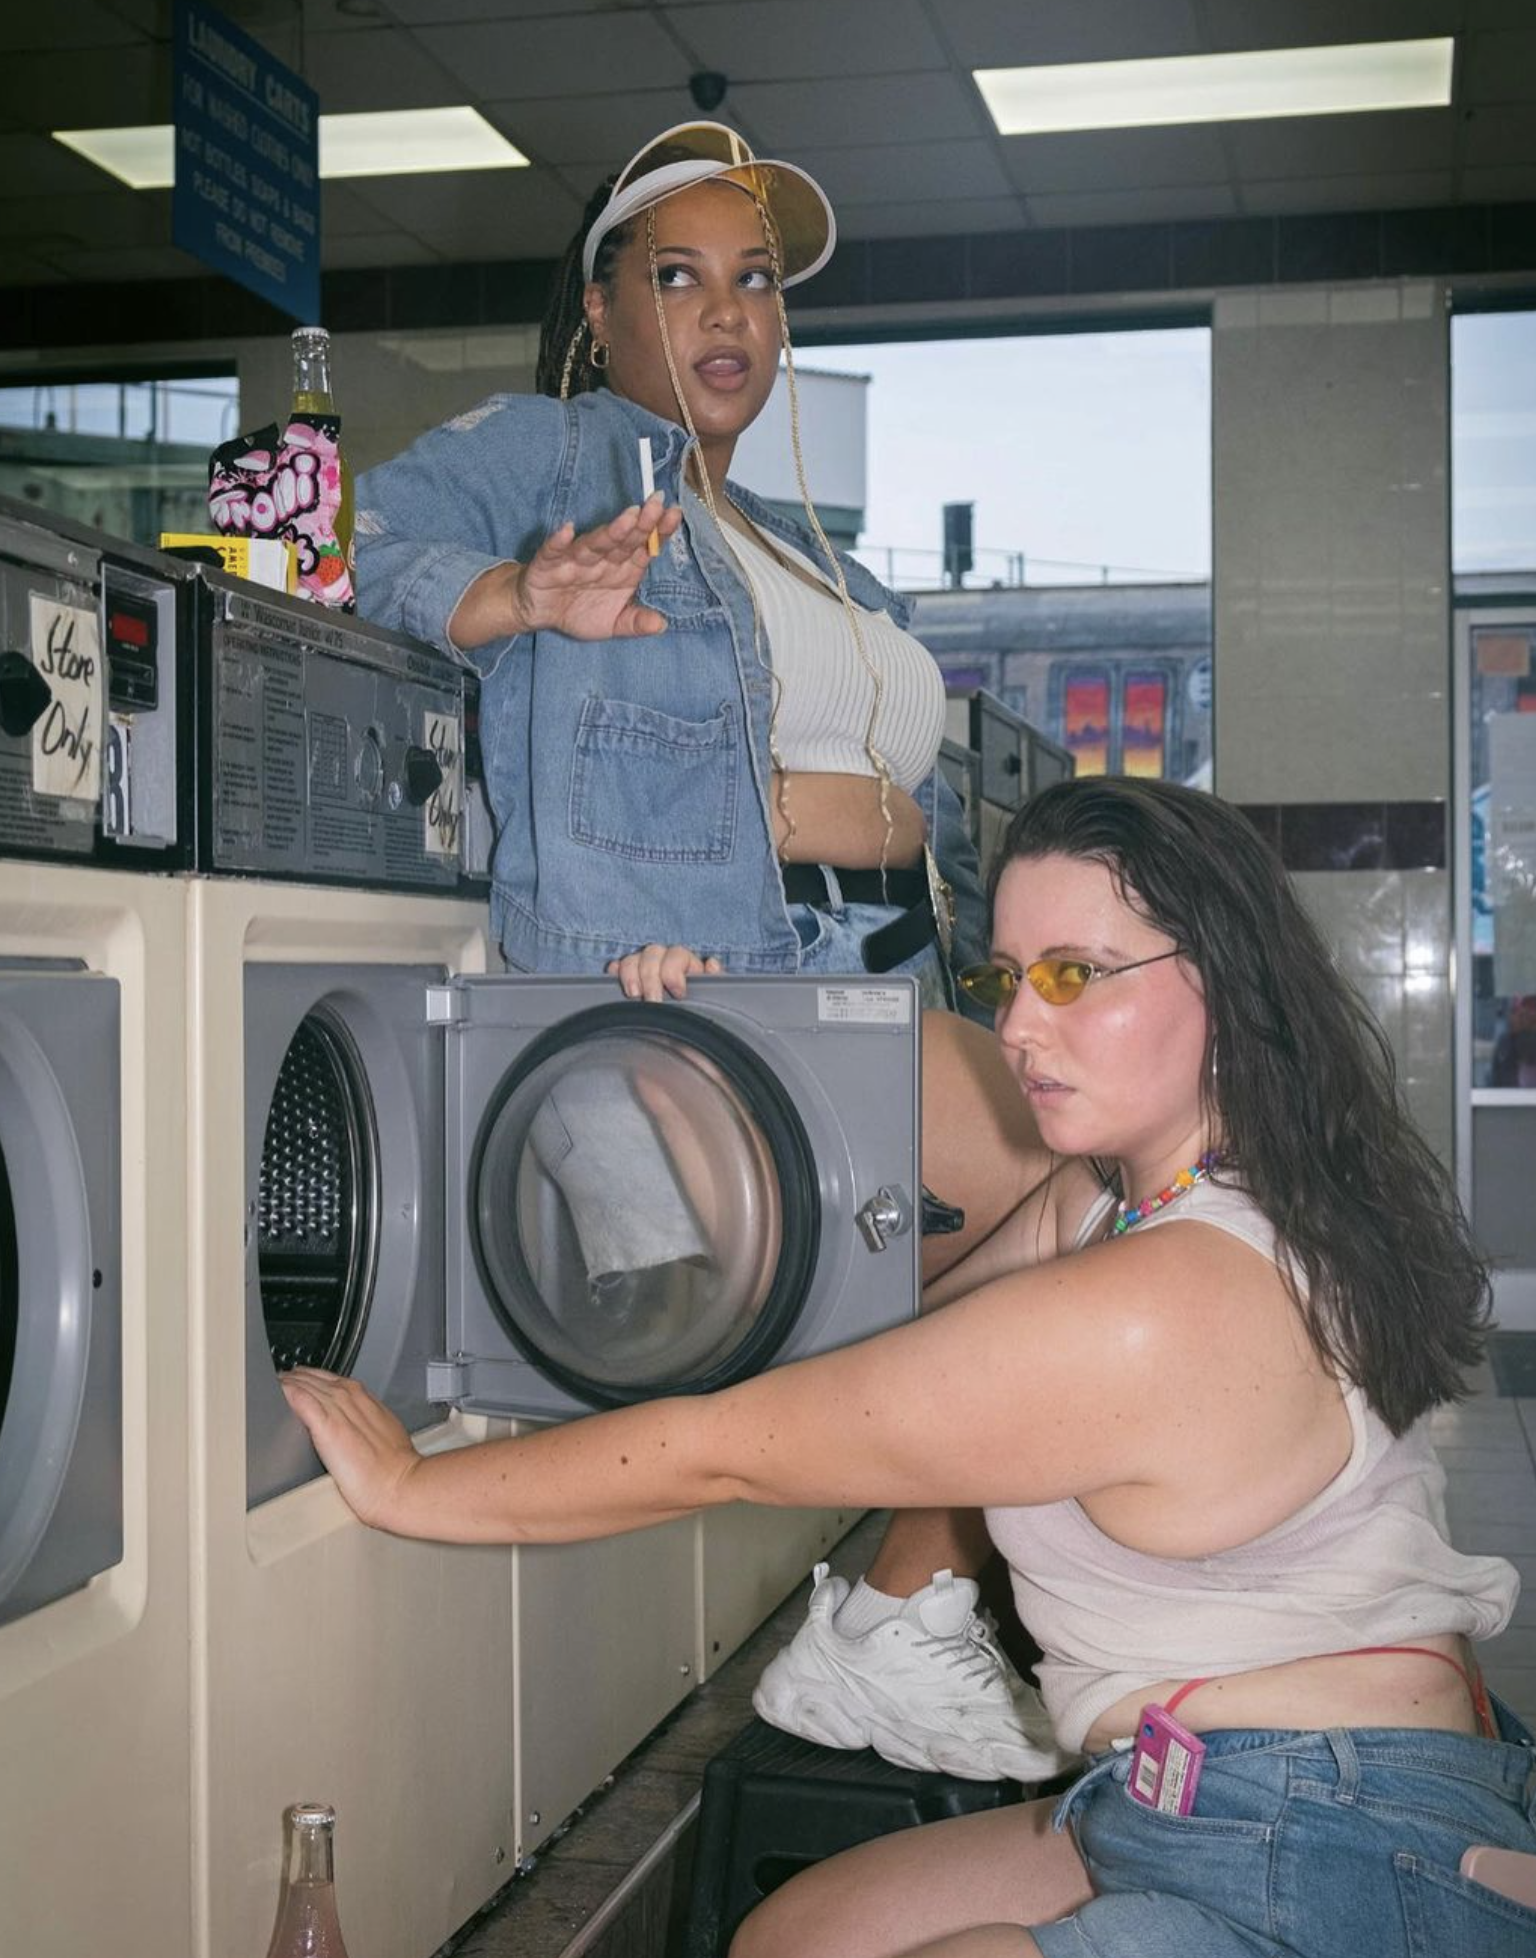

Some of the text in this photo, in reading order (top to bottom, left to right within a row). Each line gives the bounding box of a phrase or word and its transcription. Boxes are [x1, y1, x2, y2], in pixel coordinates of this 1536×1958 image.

[182, 72, 204, 110] FOR
[188, 12, 310, 134] LAUNDRY CARTS
[193, 170, 229, 212] PLEASE
[231, 196, 247, 225] DO
[248, 207, 269, 235] NOT
[214, 221, 242, 256] FROM
[209, 453, 316, 533] Trolli
[40, 614, 95, 688] Store
[41, 700, 93, 789] Only
